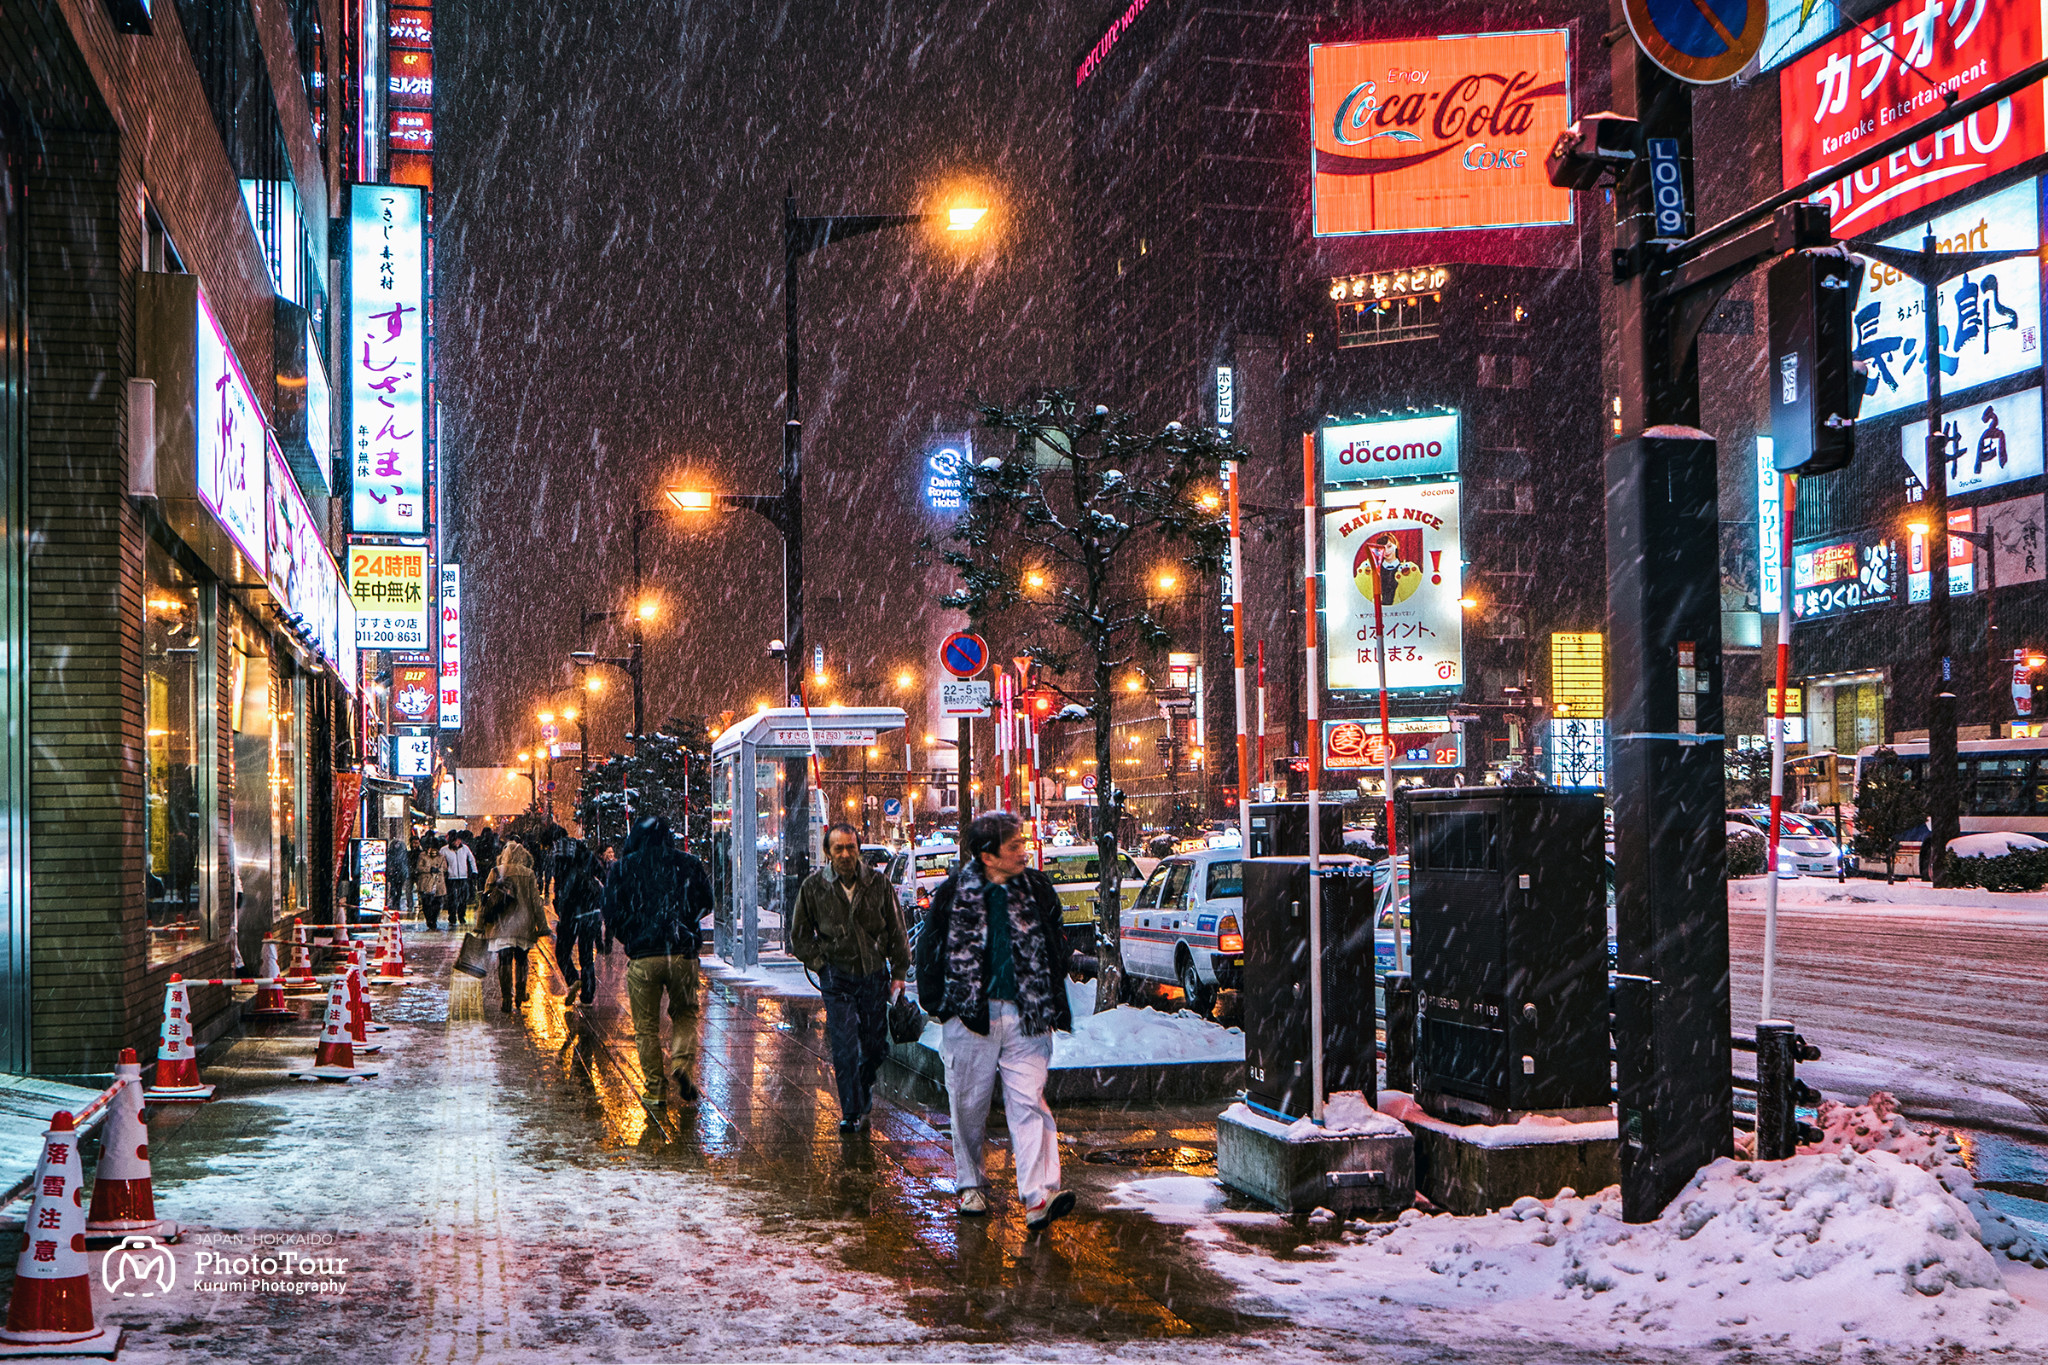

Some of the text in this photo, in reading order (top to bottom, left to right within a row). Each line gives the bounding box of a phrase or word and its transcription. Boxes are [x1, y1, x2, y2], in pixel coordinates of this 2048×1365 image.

[403, 55, 418, 65] 6F
[389, 77, 432, 95] ミルク村
[1387, 67, 1430, 84] Enjoy
[1821, 58, 1988, 155] Karaoke Entertainment
[1463, 144, 1528, 171] Coke
[1655, 143, 1681, 231] L009
[363, 302, 416, 504] すしざんまい
[357, 425, 370, 477] 年中無休
[1339, 441, 1442, 465] docomo
[933, 497, 960, 507] Hotel
[1421, 489, 1455, 497] docomo
[1339, 508, 1444, 537] HAVE A NICE
[354, 554, 422, 578] 24時間
[353, 580, 422, 603] 年中無休
[1805, 582, 1861, 616] 生つくね
[358, 617, 418, 629] すすきの店
[441, 714, 460, 723] 本店
[1436, 749, 1458, 764] 2F
[167, 991, 183, 1053] 落雪注意
[33, 1142, 69, 1263] 落雪注意
